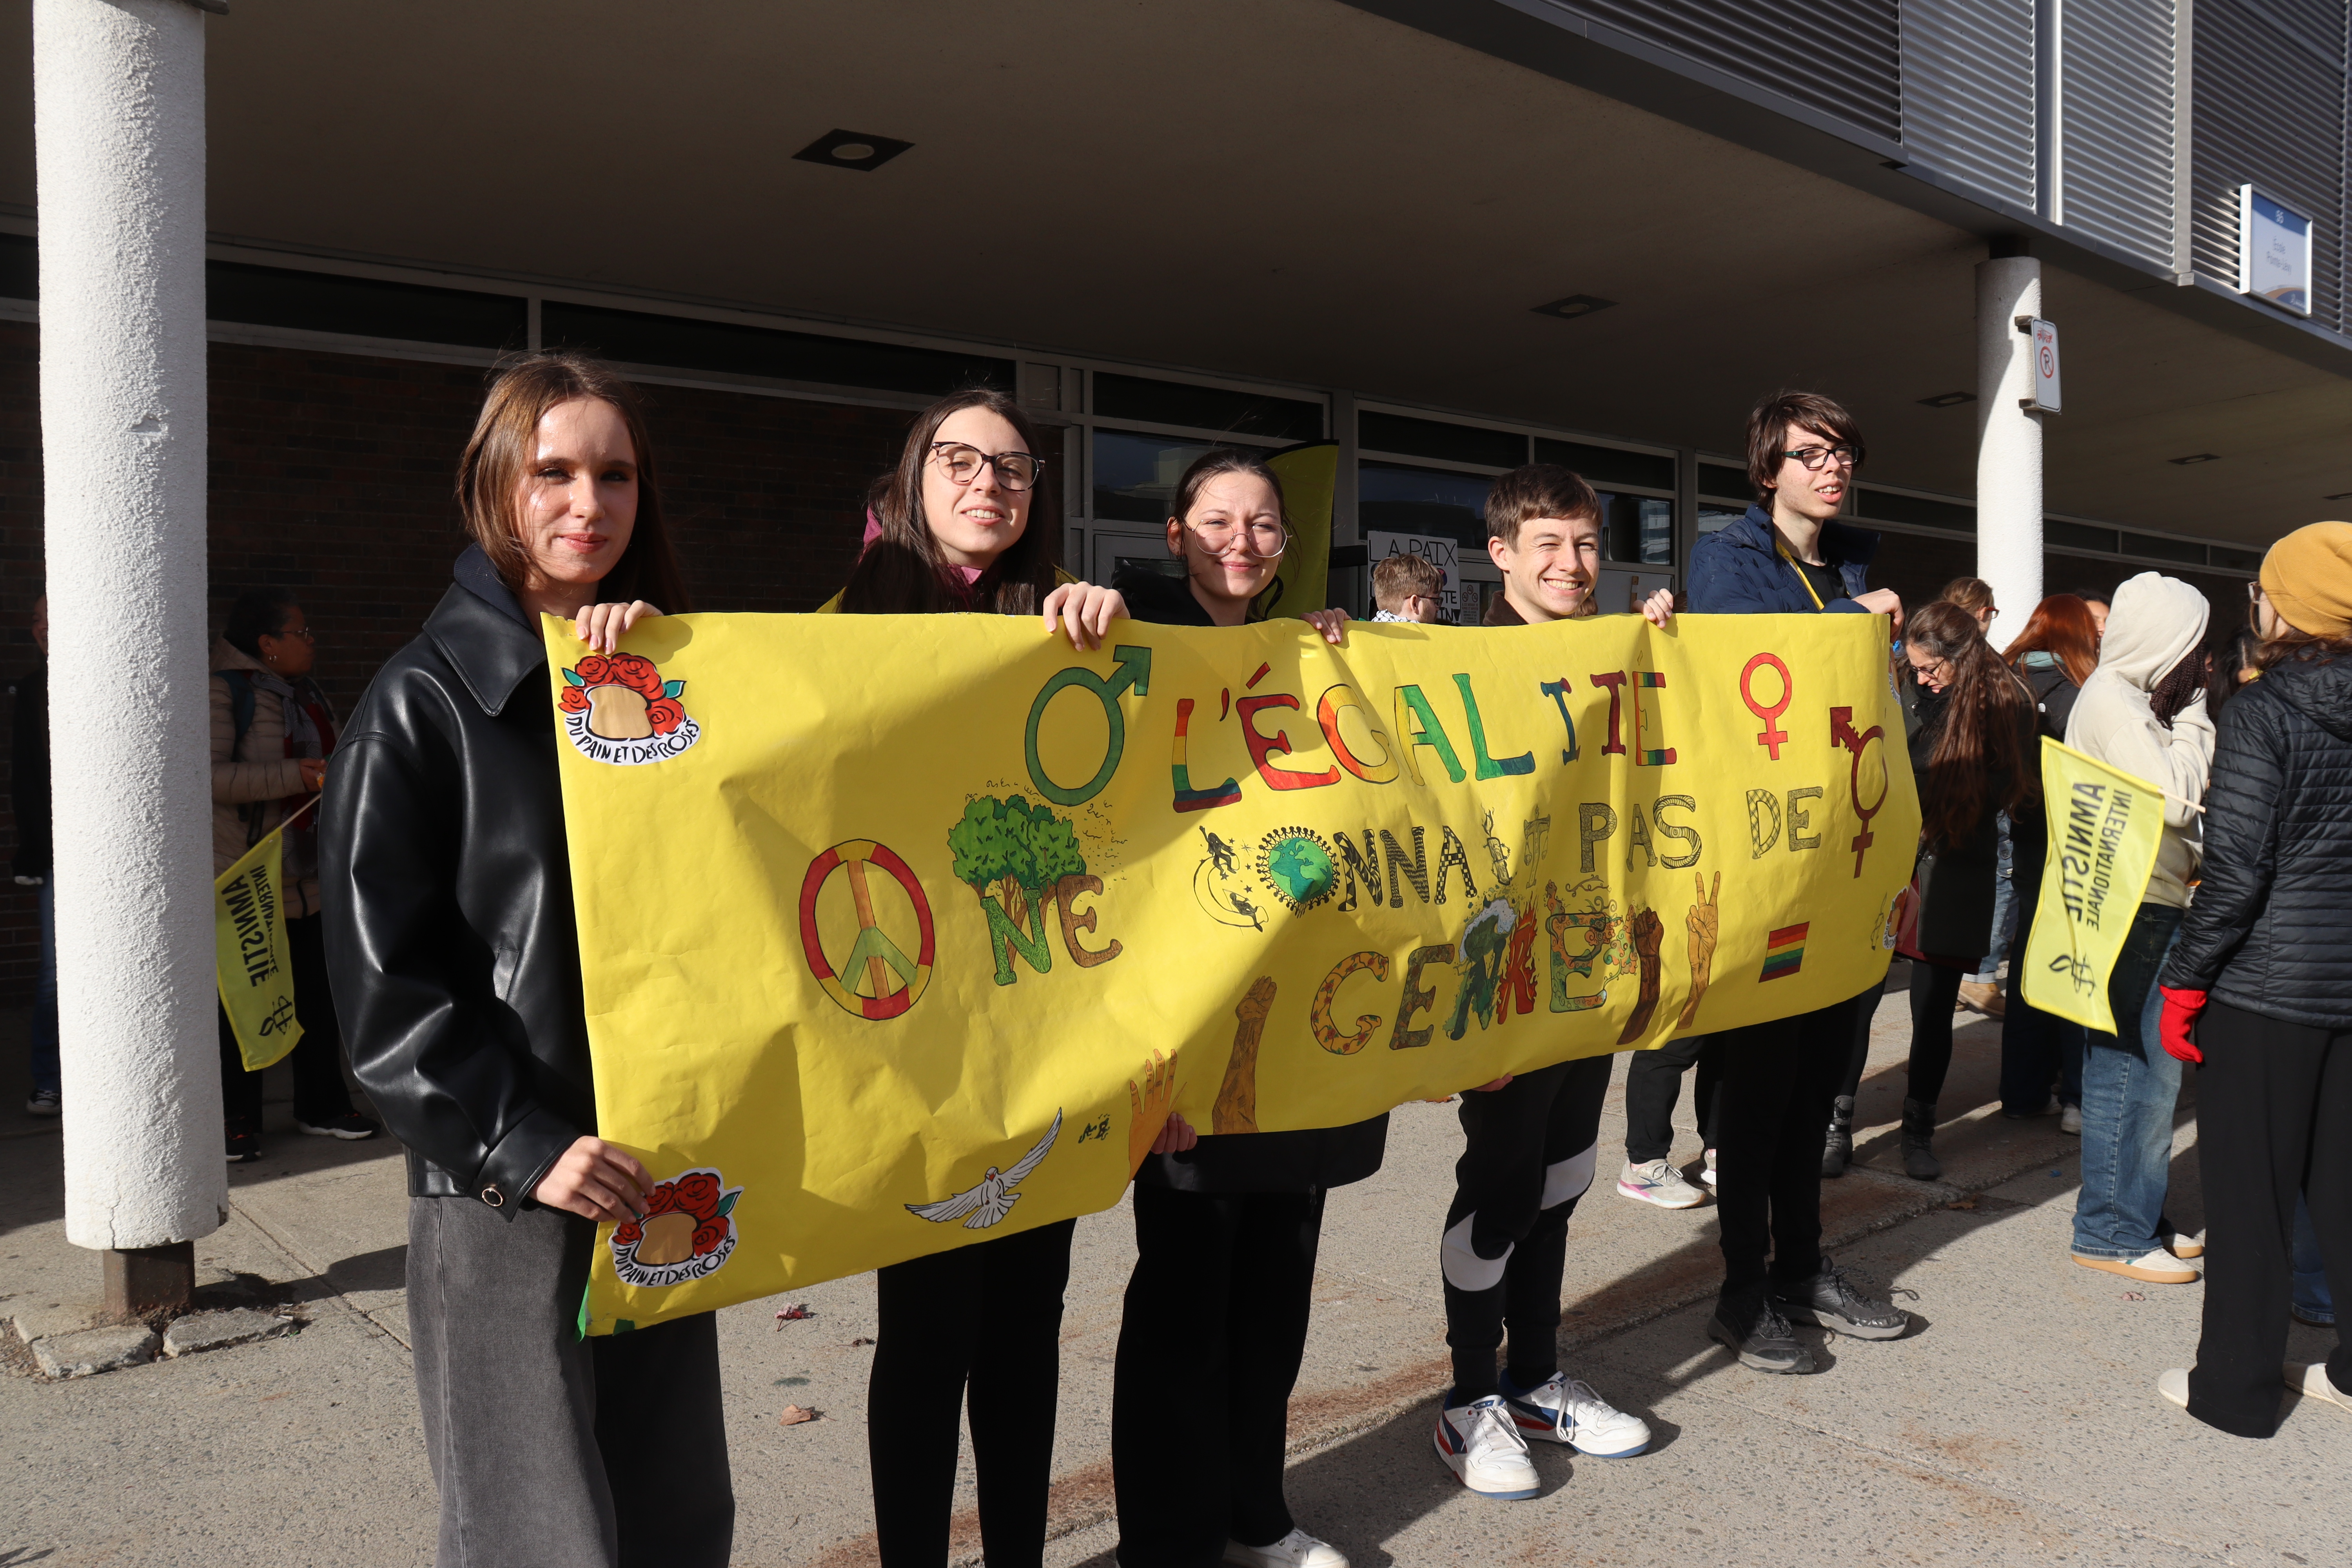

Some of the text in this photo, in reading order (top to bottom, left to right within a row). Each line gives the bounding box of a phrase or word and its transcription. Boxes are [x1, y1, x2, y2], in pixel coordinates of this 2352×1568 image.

[1369, 539, 1457, 567] LA PAIX
[566, 716, 699, 763] DU PAIN ET DES ROSES
[1171, 650, 1677, 813] L'ÉGALITÉ
[980, 874, 1123, 986] NE
[1579, 795, 1703, 873] PAS
[1746, 786, 1824, 860] DE
[1310, 894, 1611, 1055] GENRE
[615, 1236, 736, 1286] DU PAIN ET DES ROSES
